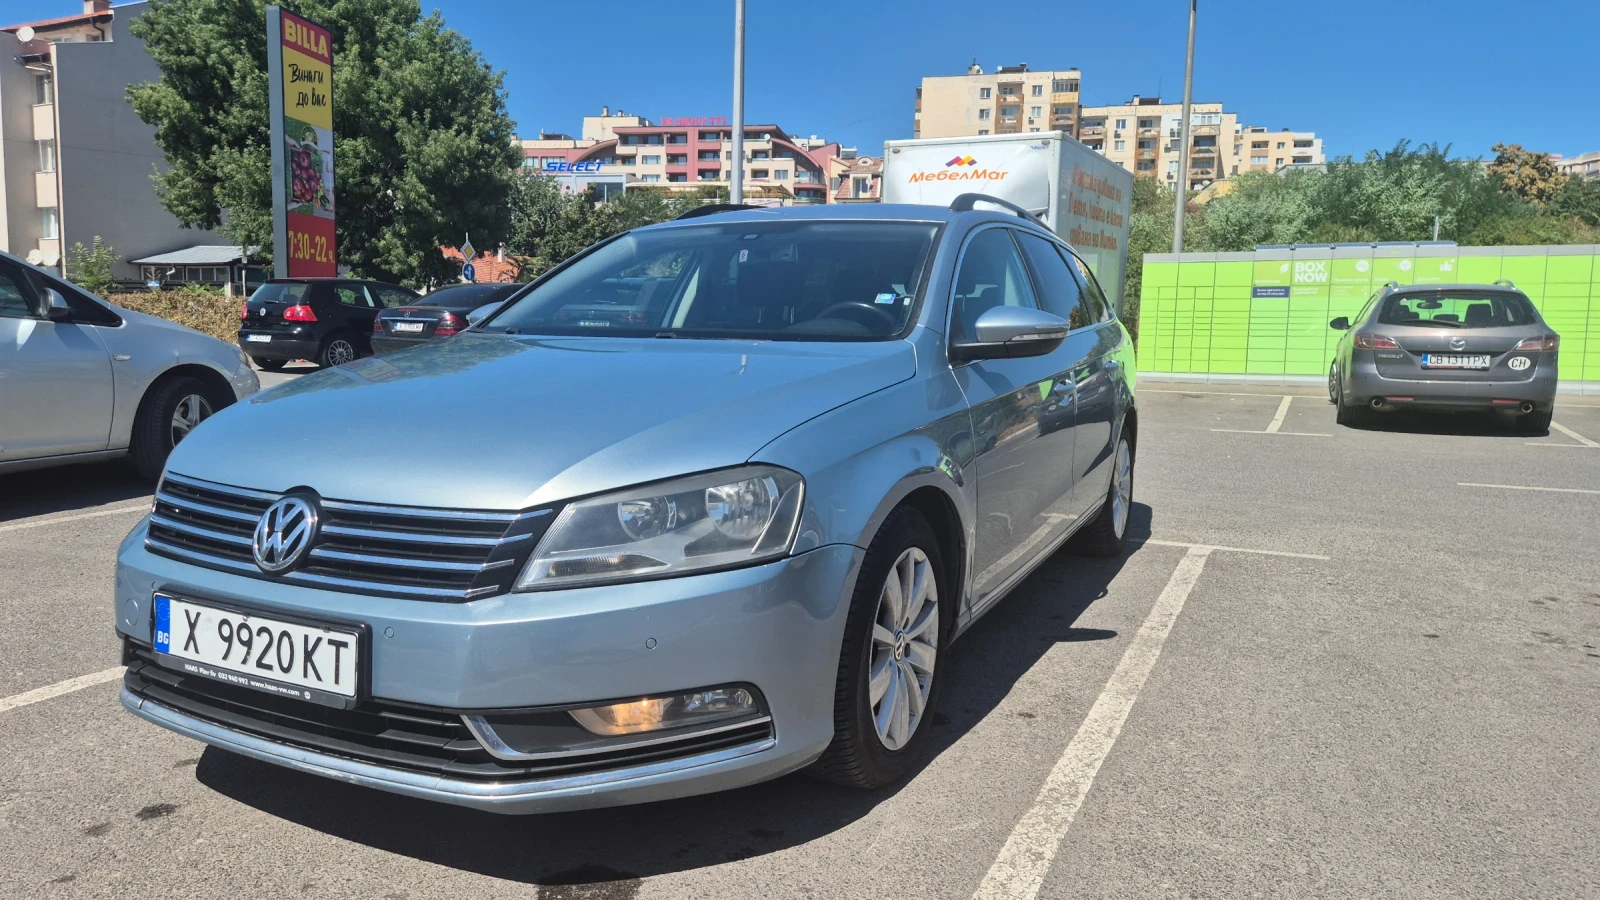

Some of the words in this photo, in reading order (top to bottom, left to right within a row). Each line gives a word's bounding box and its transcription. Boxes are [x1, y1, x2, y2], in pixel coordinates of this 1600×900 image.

[284, 18, 329, 58] BILLA
[288, 63, 324, 84] Винаги
[296, 91, 309, 108] до
[542, 161, 607, 172] SELECT
[1294, 261, 1326, 273] BOX
[1294, 272, 1328, 283] NOW
[1429, 355, 1443, 364] CB
[1511, 358, 1527, 368] CH
[157, 630, 169, 645] BG
[183, 608, 202, 654] X
[184, 663, 198, 673] HAAS
[250, 679, 299, 697] www.haas-vw.com
